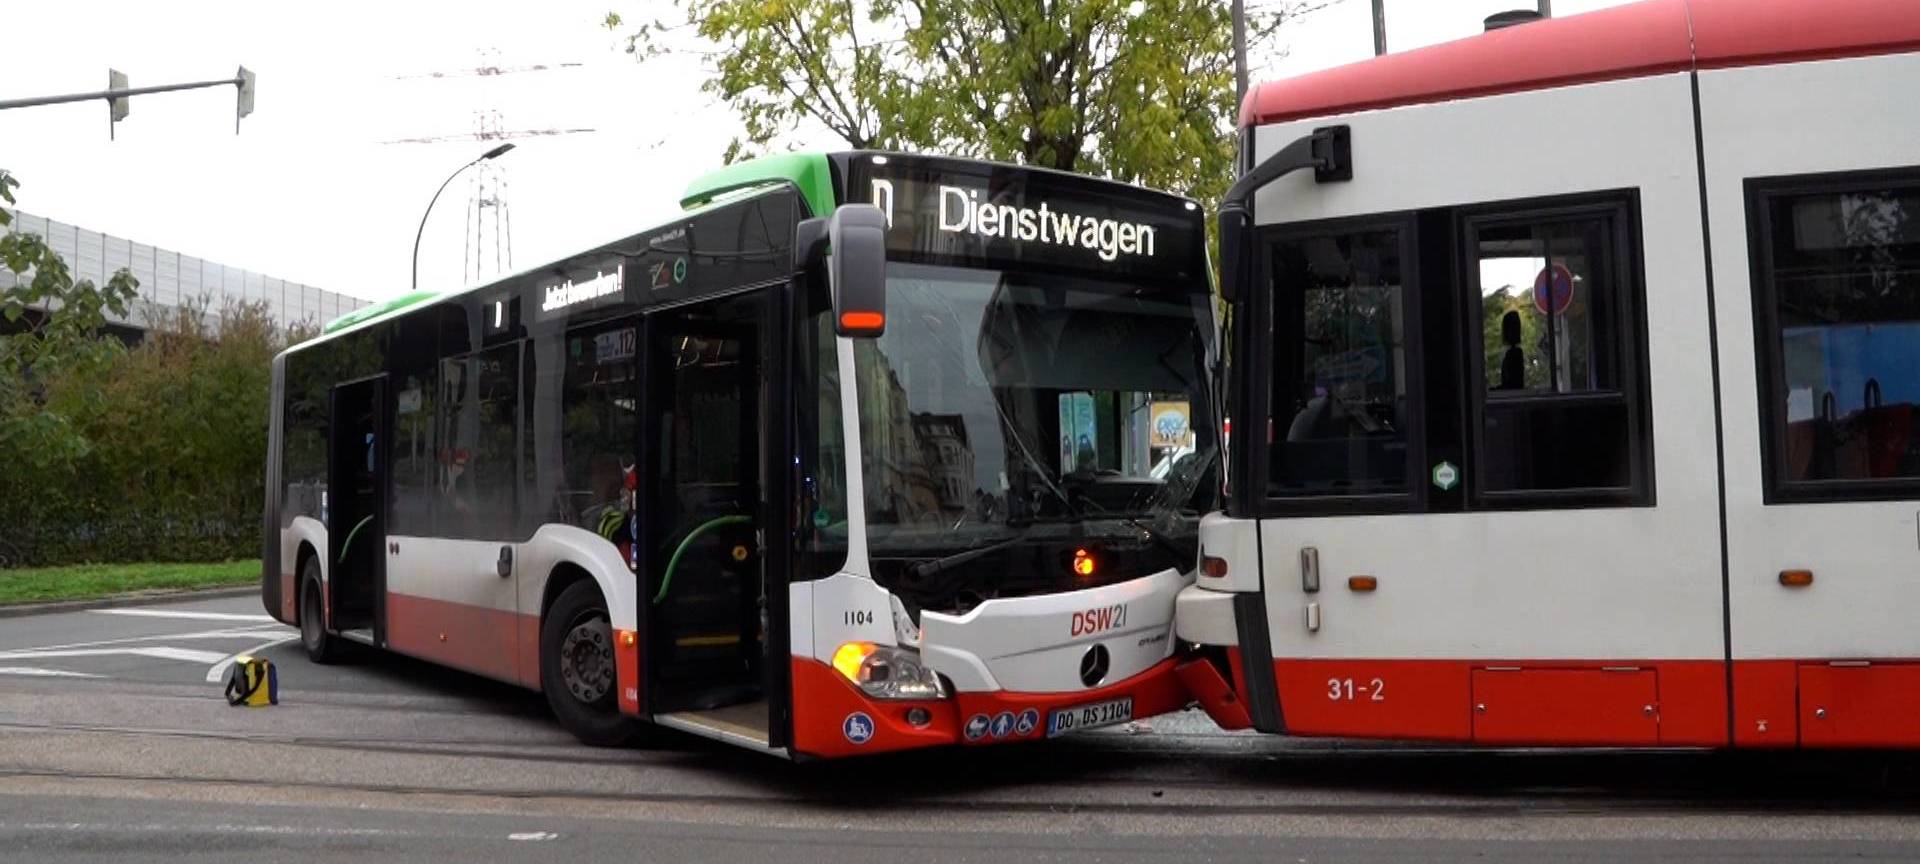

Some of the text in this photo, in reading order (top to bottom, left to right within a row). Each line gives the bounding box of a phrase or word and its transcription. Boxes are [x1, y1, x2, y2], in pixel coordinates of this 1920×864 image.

[938, 185, 1154, 260] Dienstwagen
[843, 610, 874, 626] 1104
[1071, 604, 1128, 637] DSW21
[1326, 677, 1386, 701] 31-2
[1056, 701, 1130, 730] DO DS 1104
